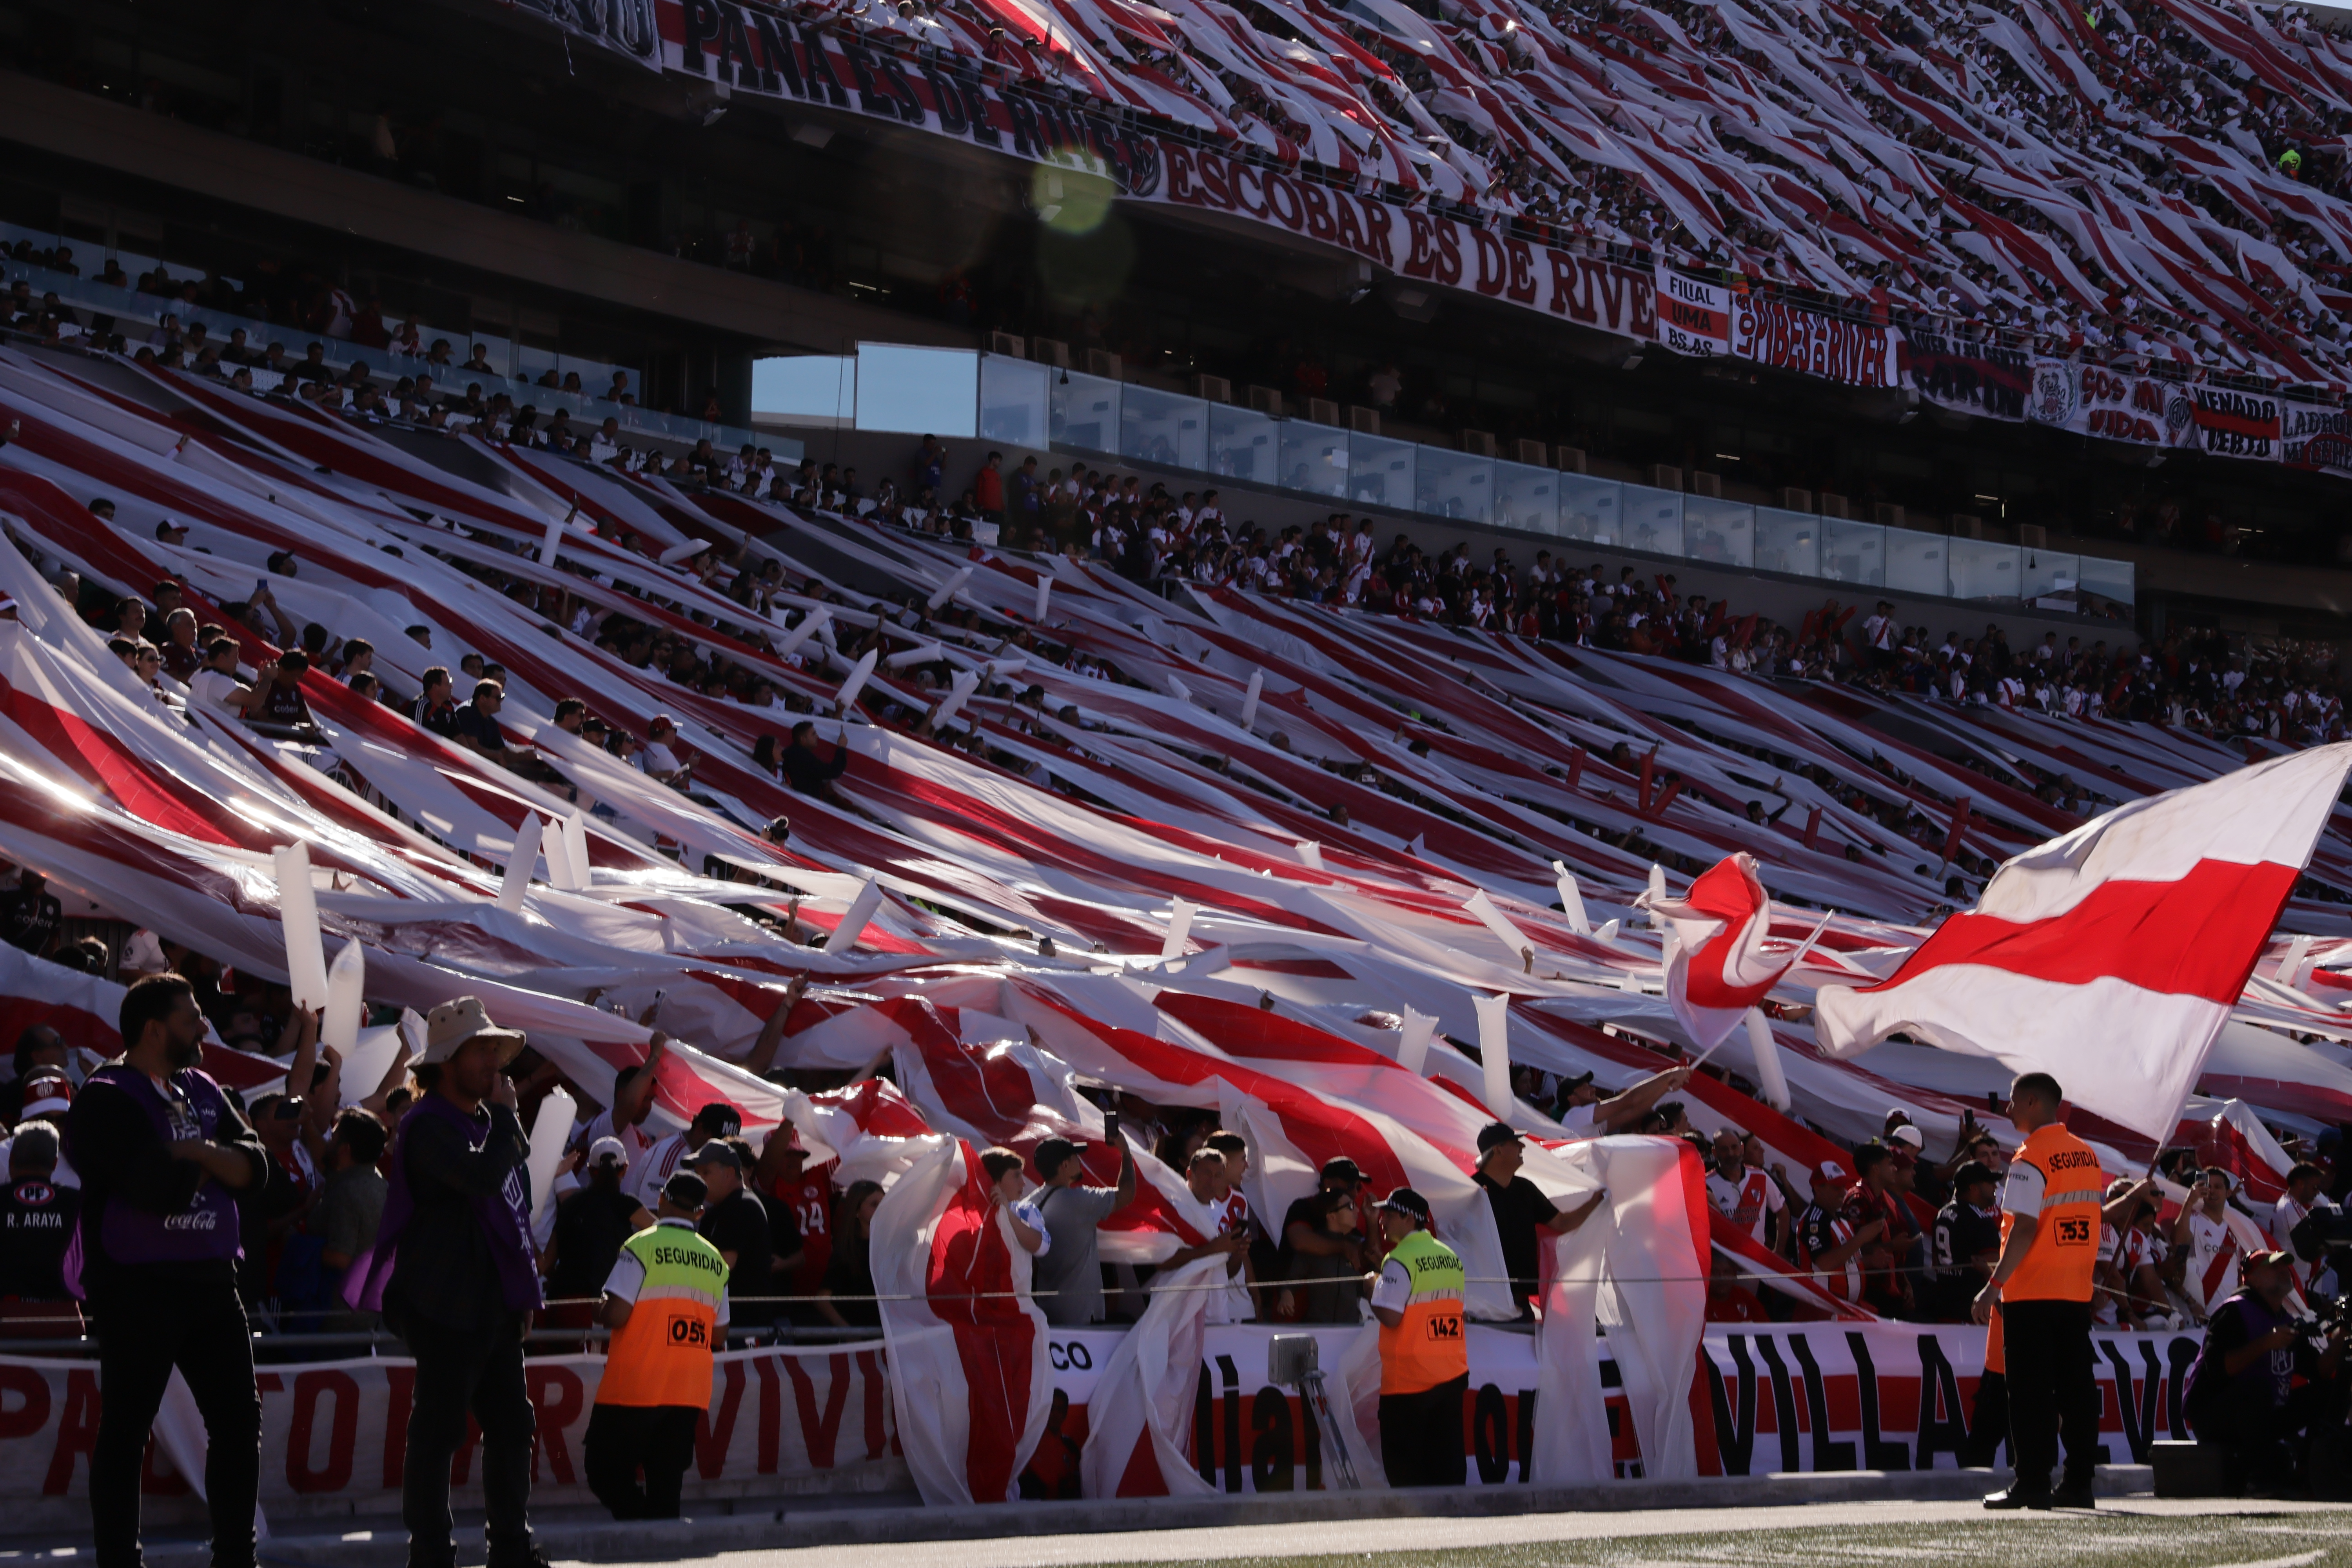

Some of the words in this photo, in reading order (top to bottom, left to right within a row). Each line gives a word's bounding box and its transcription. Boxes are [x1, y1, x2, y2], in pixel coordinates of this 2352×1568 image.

[683, 0, 851, 108] PANA
[840, 39, 925, 124] ES
[919, 66, 1002, 148] DE
[1156, 140, 1393, 267] ESCOBAR
[1402, 209, 1462, 285] ES
[1471, 226, 1536, 304] DE
[1546, 249, 1659, 339] RIVE
[1670, 276, 1715, 306] FILIAL
[1672, 302, 1712, 331] LIMA
[1736, 294, 1756, 355] LOS
[1753, 299, 1814, 372] PIBES
[1813, 313, 1827, 373] DE
[1826, 316, 1888, 387] RIVER
[2081, 367, 2127, 407] SOS
[2134, 380, 2164, 417] MI
[2192, 387, 2276, 424] VENADO
[2088, 409, 2160, 442] VIDA
[7, 1212, 19, 1229] R.
[24, 1212, 62, 1229] ARAYA
[797, 1200, 825, 1236] 14
[655, 1247, 722, 1276] SEGURIDAD
[1935, 1224, 1953, 1265] 9
[1430, 1318, 1459, 1337] 142
[693, 1347, 904, 1480] VIVI
[1702, 1332, 1975, 1475] VILLA
